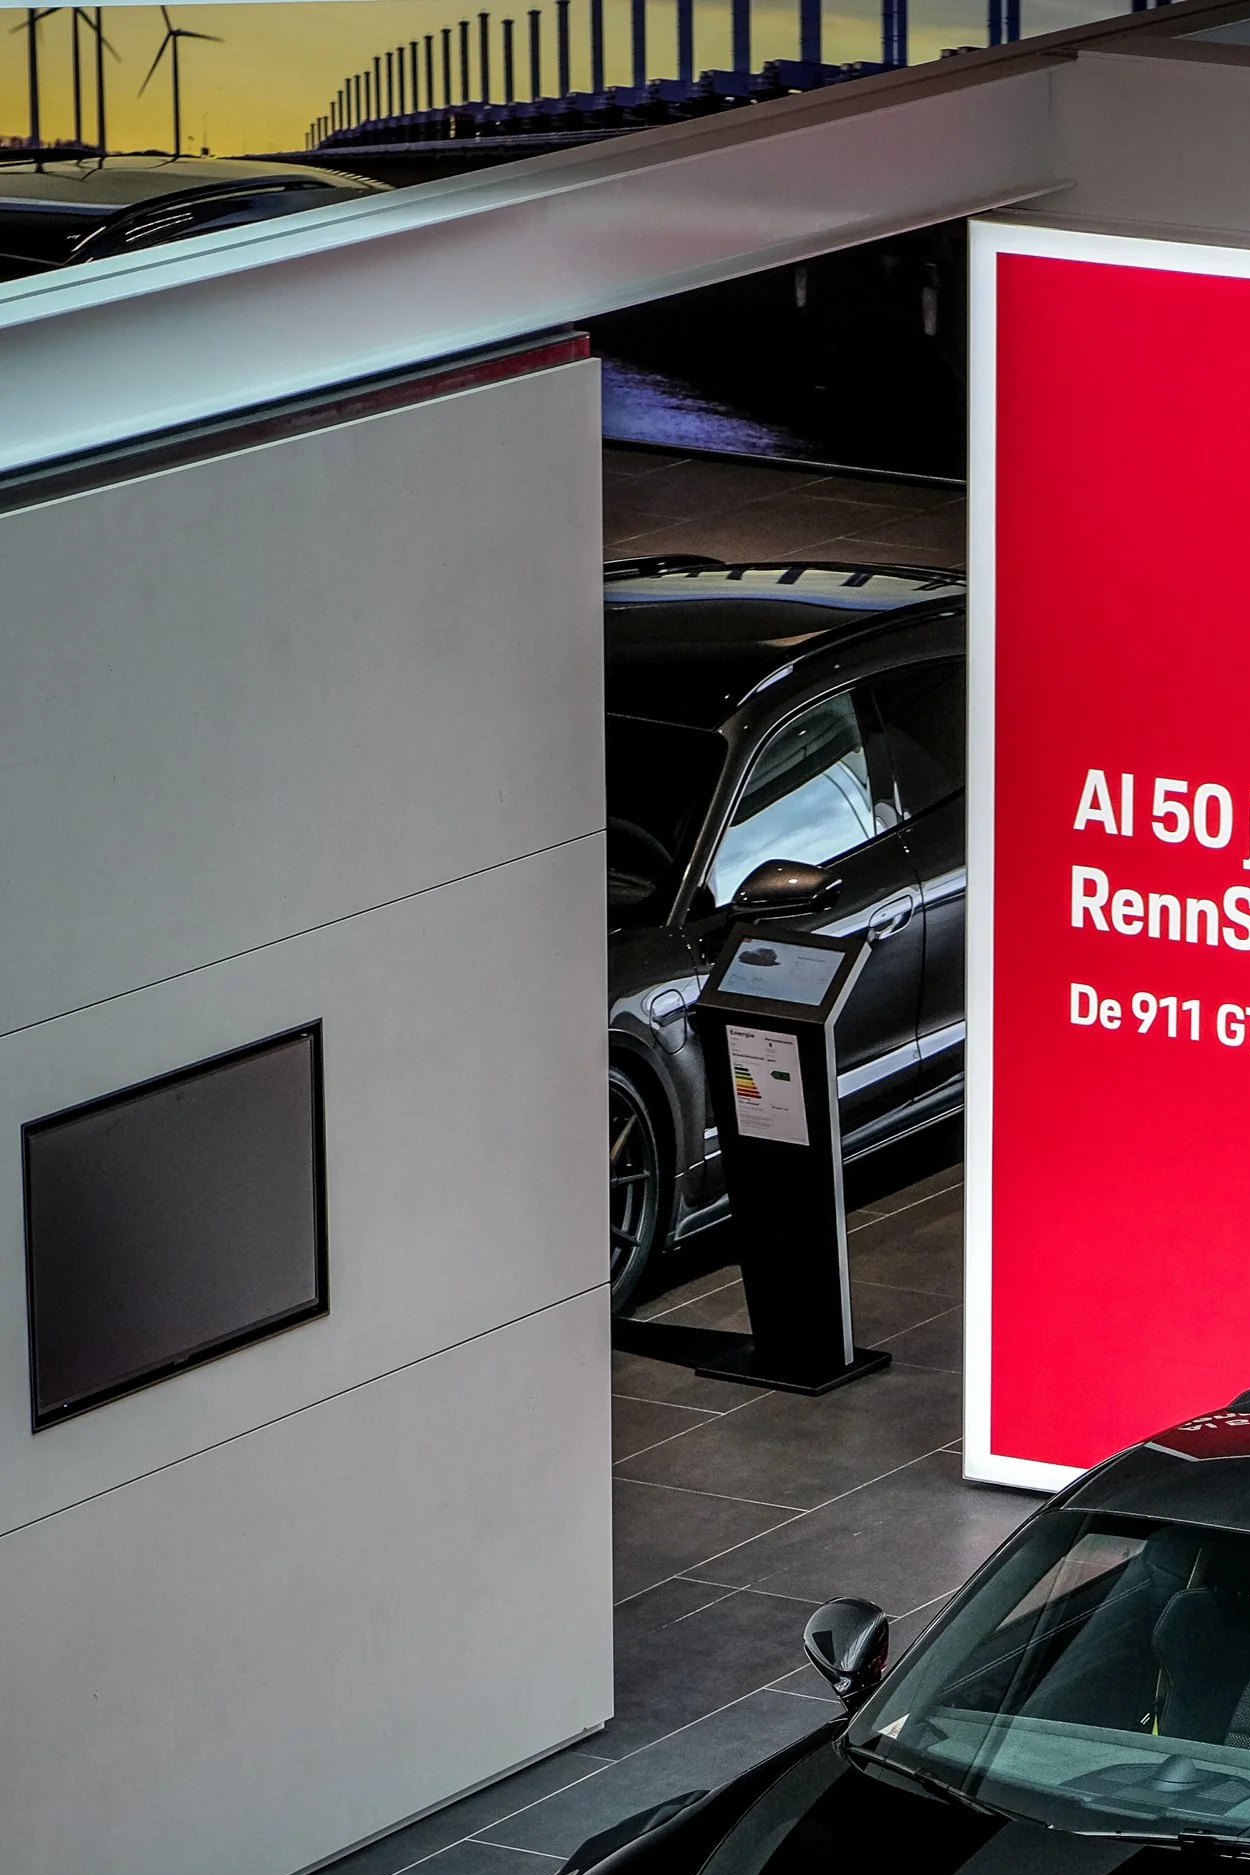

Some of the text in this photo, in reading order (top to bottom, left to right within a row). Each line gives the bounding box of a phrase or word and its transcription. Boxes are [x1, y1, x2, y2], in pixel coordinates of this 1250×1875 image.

[1073, 768, 1134, 837] Al
[1151, 777, 1233, 849] 50
[1070, 982, 1122, 1030] De
[1131, 991, 1201, 1041] 911
